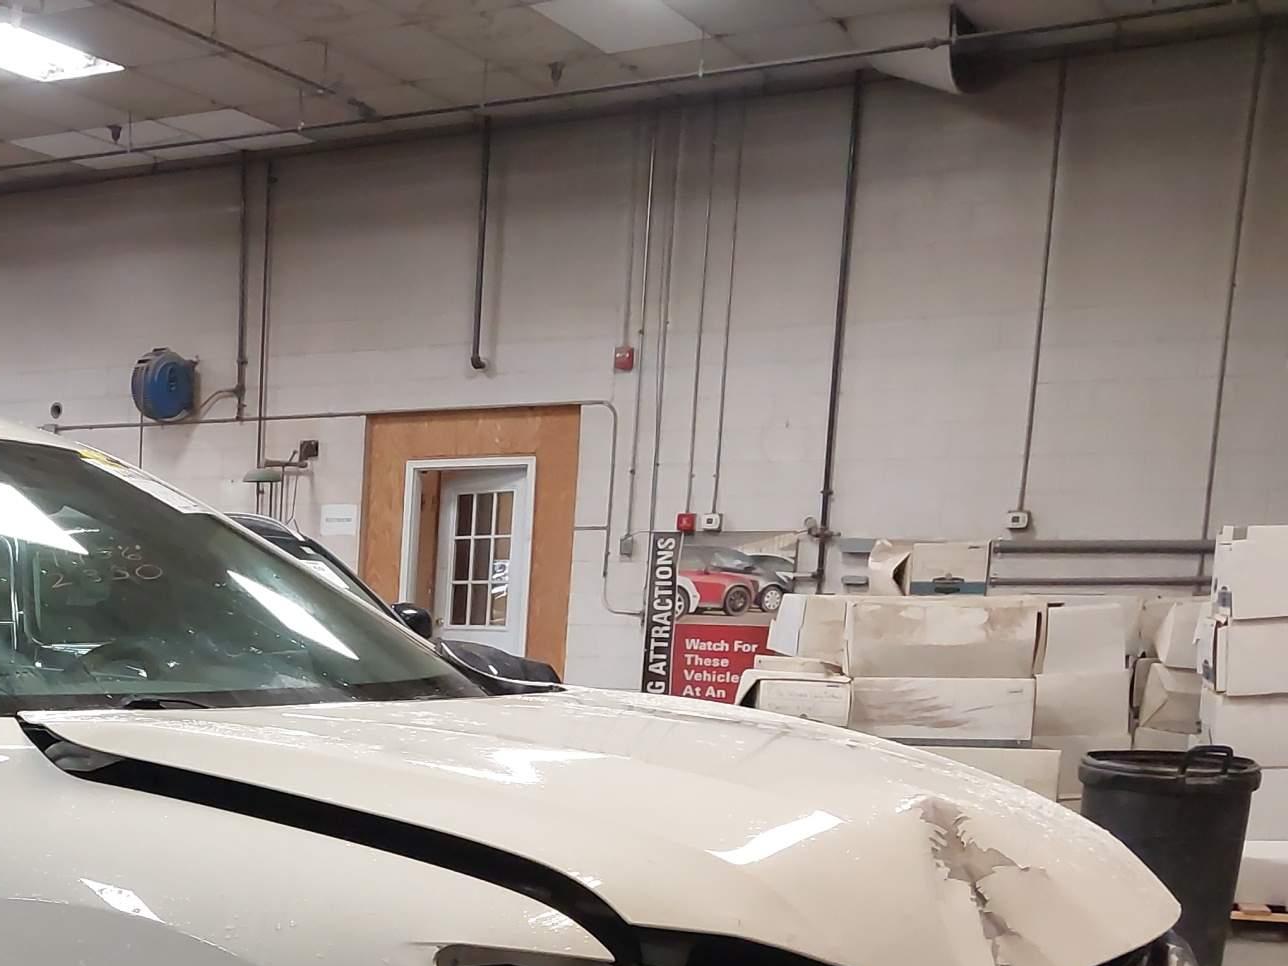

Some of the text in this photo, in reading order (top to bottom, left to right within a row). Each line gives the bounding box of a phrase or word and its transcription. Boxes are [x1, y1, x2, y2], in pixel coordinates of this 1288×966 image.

[648, 537, 676, 675] ATTRACTIONS
[685, 638, 758, 653] Watch For
[685, 654, 729, 667] These
[683, 669, 741, 684] Vehicle
[682, 685, 726, 698] At An
